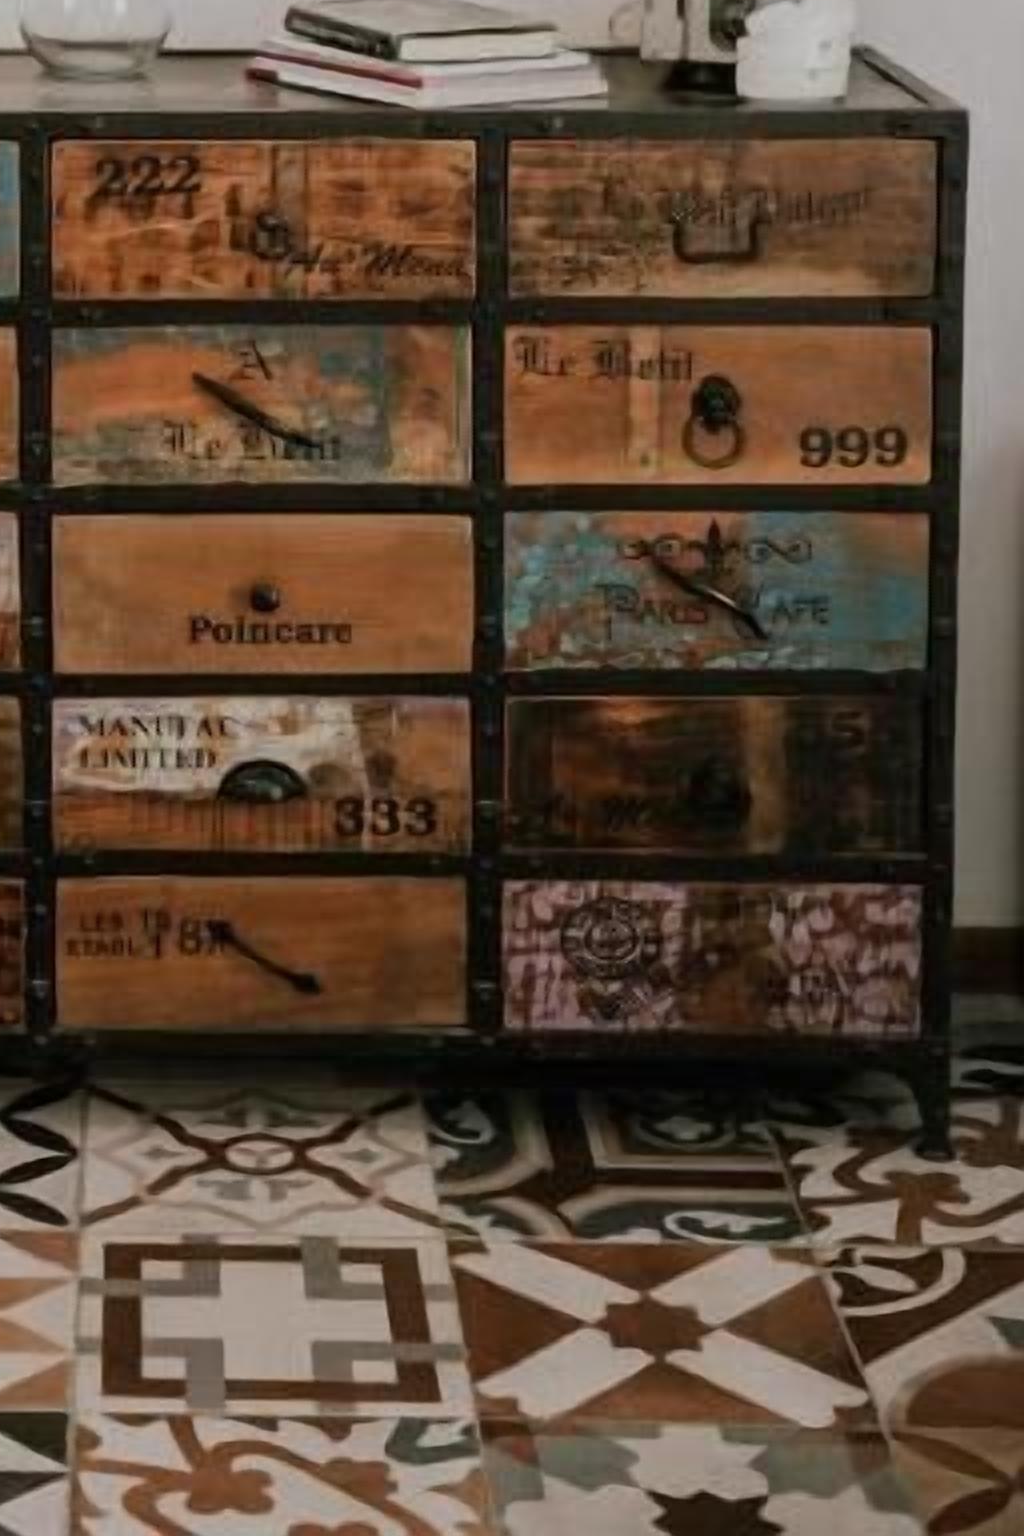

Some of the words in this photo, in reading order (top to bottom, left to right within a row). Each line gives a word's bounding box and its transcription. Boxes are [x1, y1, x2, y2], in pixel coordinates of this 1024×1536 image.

[95, 156, 202, 198] 222
[799, 427, 908, 468] 999
[334, 796, 438, 837] 333
